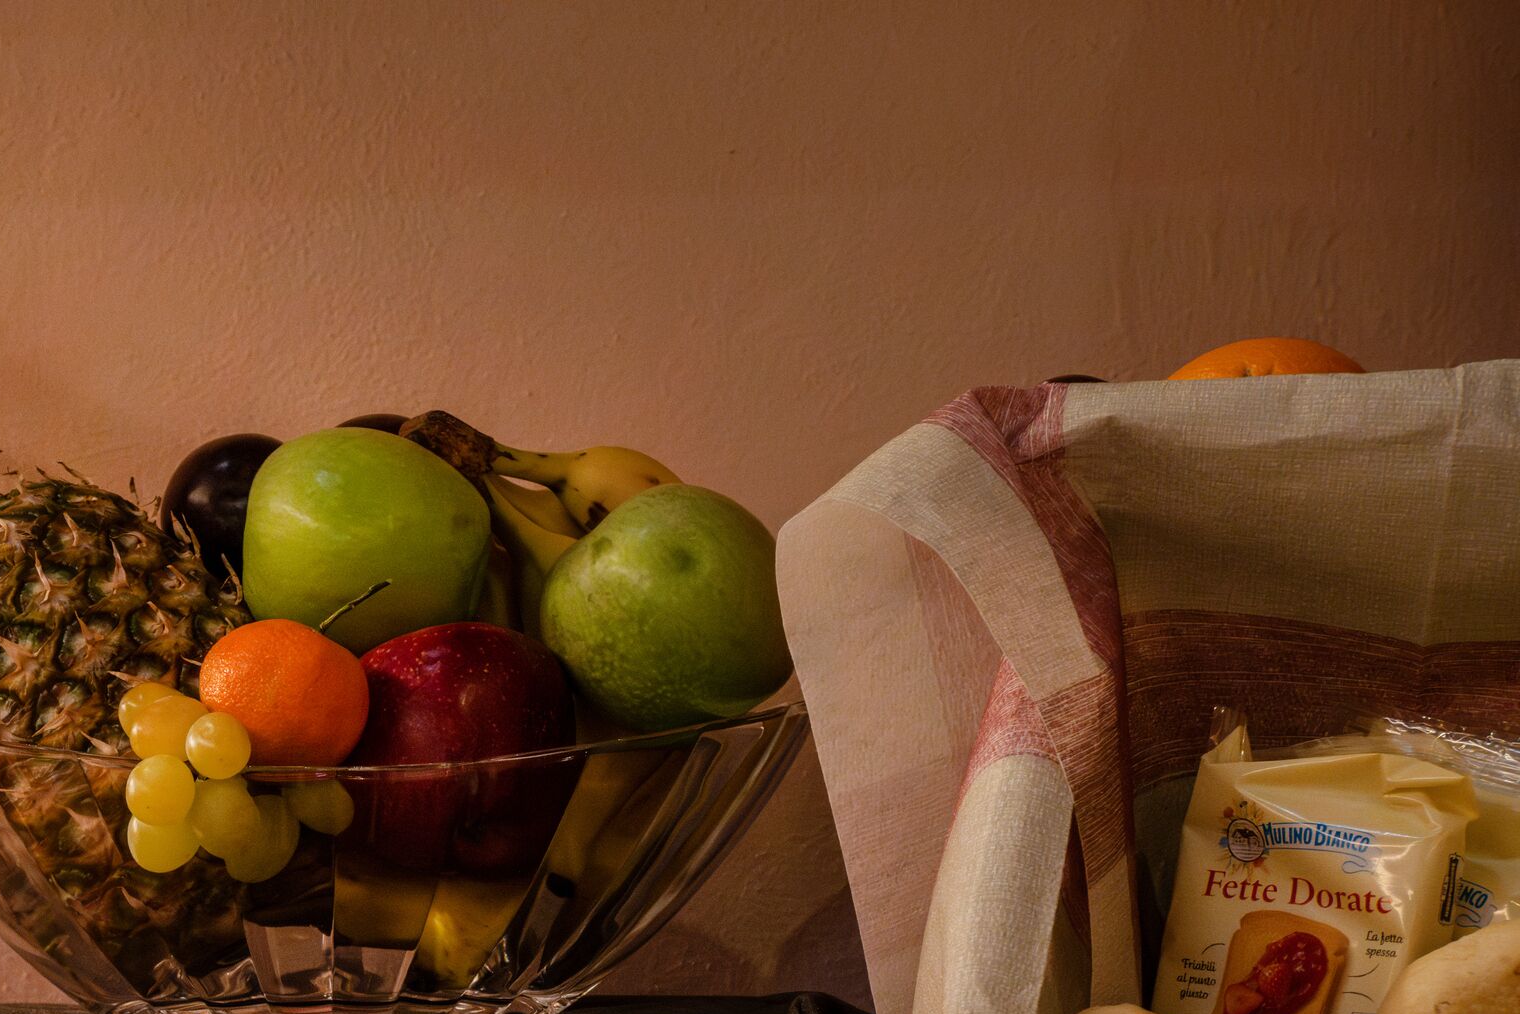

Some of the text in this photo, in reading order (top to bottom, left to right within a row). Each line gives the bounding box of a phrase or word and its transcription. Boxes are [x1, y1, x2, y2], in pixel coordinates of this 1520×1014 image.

[1203, 869, 1394, 914] Fette Dorate
[1459, 886, 1488, 909] NCO
[1365, 930, 1379, 941] La
[1365, 947, 1398, 959] spessa
[1181, 958, 1216, 972] Friabili
[1176, 972, 1187, 983] al
